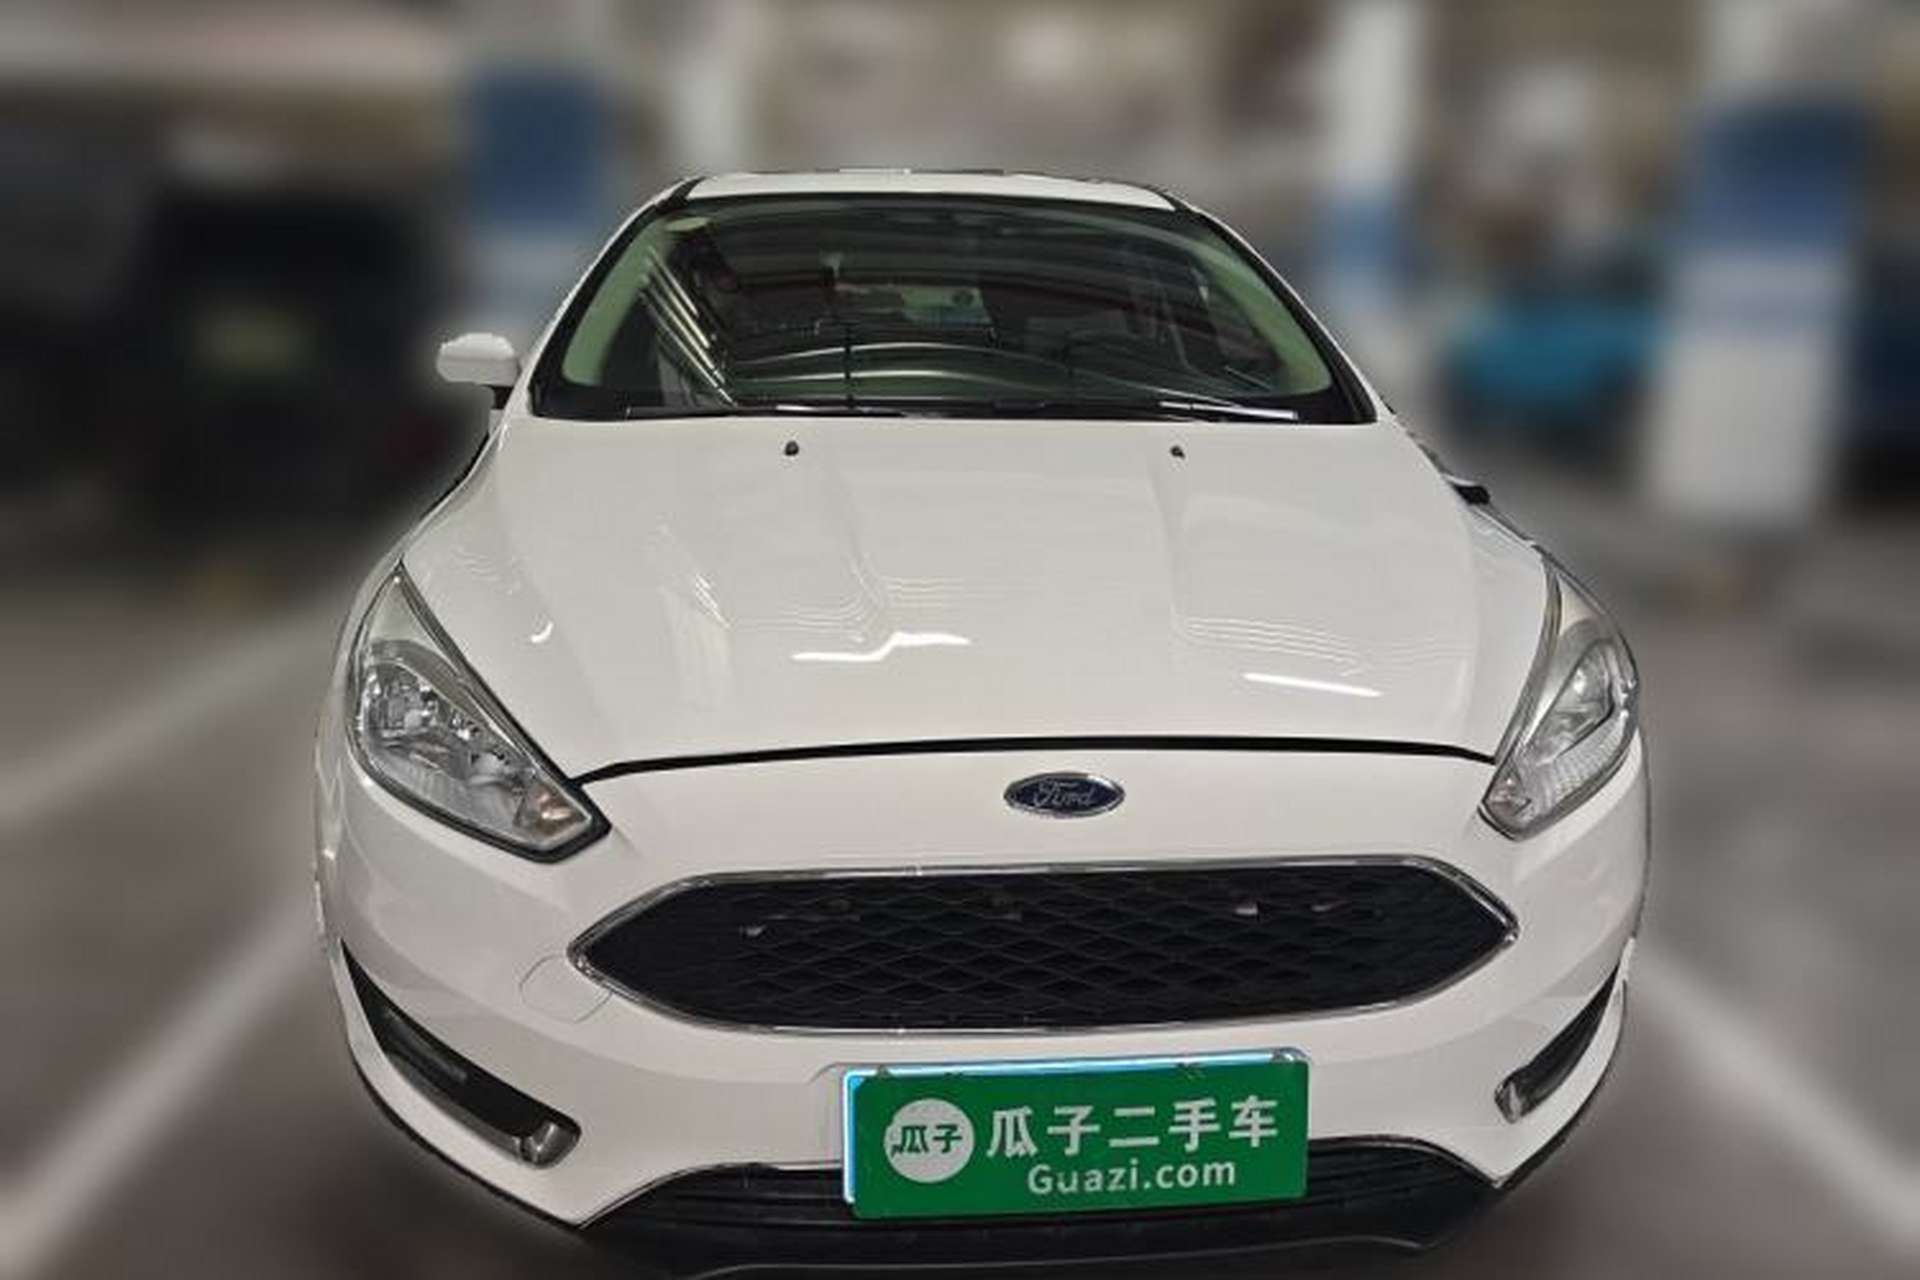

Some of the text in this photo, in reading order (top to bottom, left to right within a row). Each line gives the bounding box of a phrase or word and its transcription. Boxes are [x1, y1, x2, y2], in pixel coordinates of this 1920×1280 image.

[1033, 781, 1096, 808] Ford
[894, 1122, 964, 1155] 瓜子
[986, 1095, 1279, 1159] 瓜子二手车
[1027, 1158, 1236, 1195] Guazi.com
